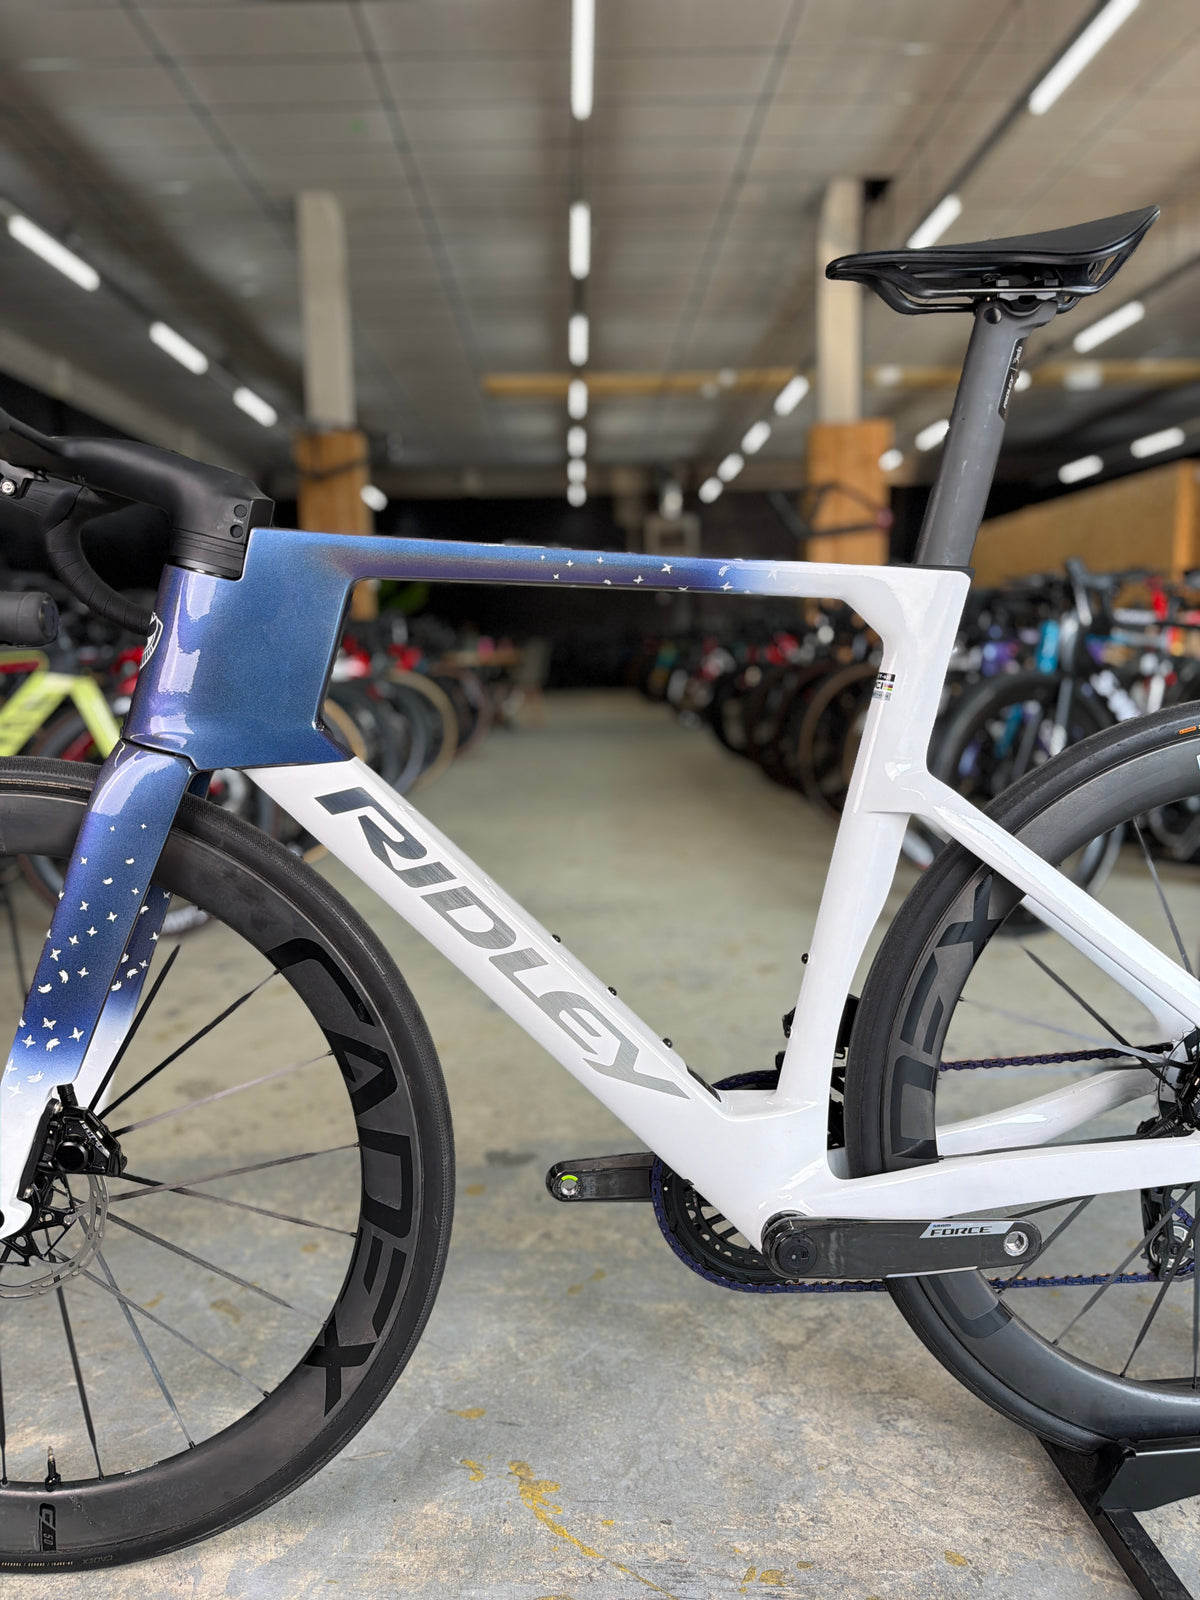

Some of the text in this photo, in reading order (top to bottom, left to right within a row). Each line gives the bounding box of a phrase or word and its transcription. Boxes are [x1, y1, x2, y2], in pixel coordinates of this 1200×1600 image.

[314, 786, 690, 1100] RIDLEY
[265, 938, 413, 1417] CADEX
[930, 1226, 993, 1236] FORCE
